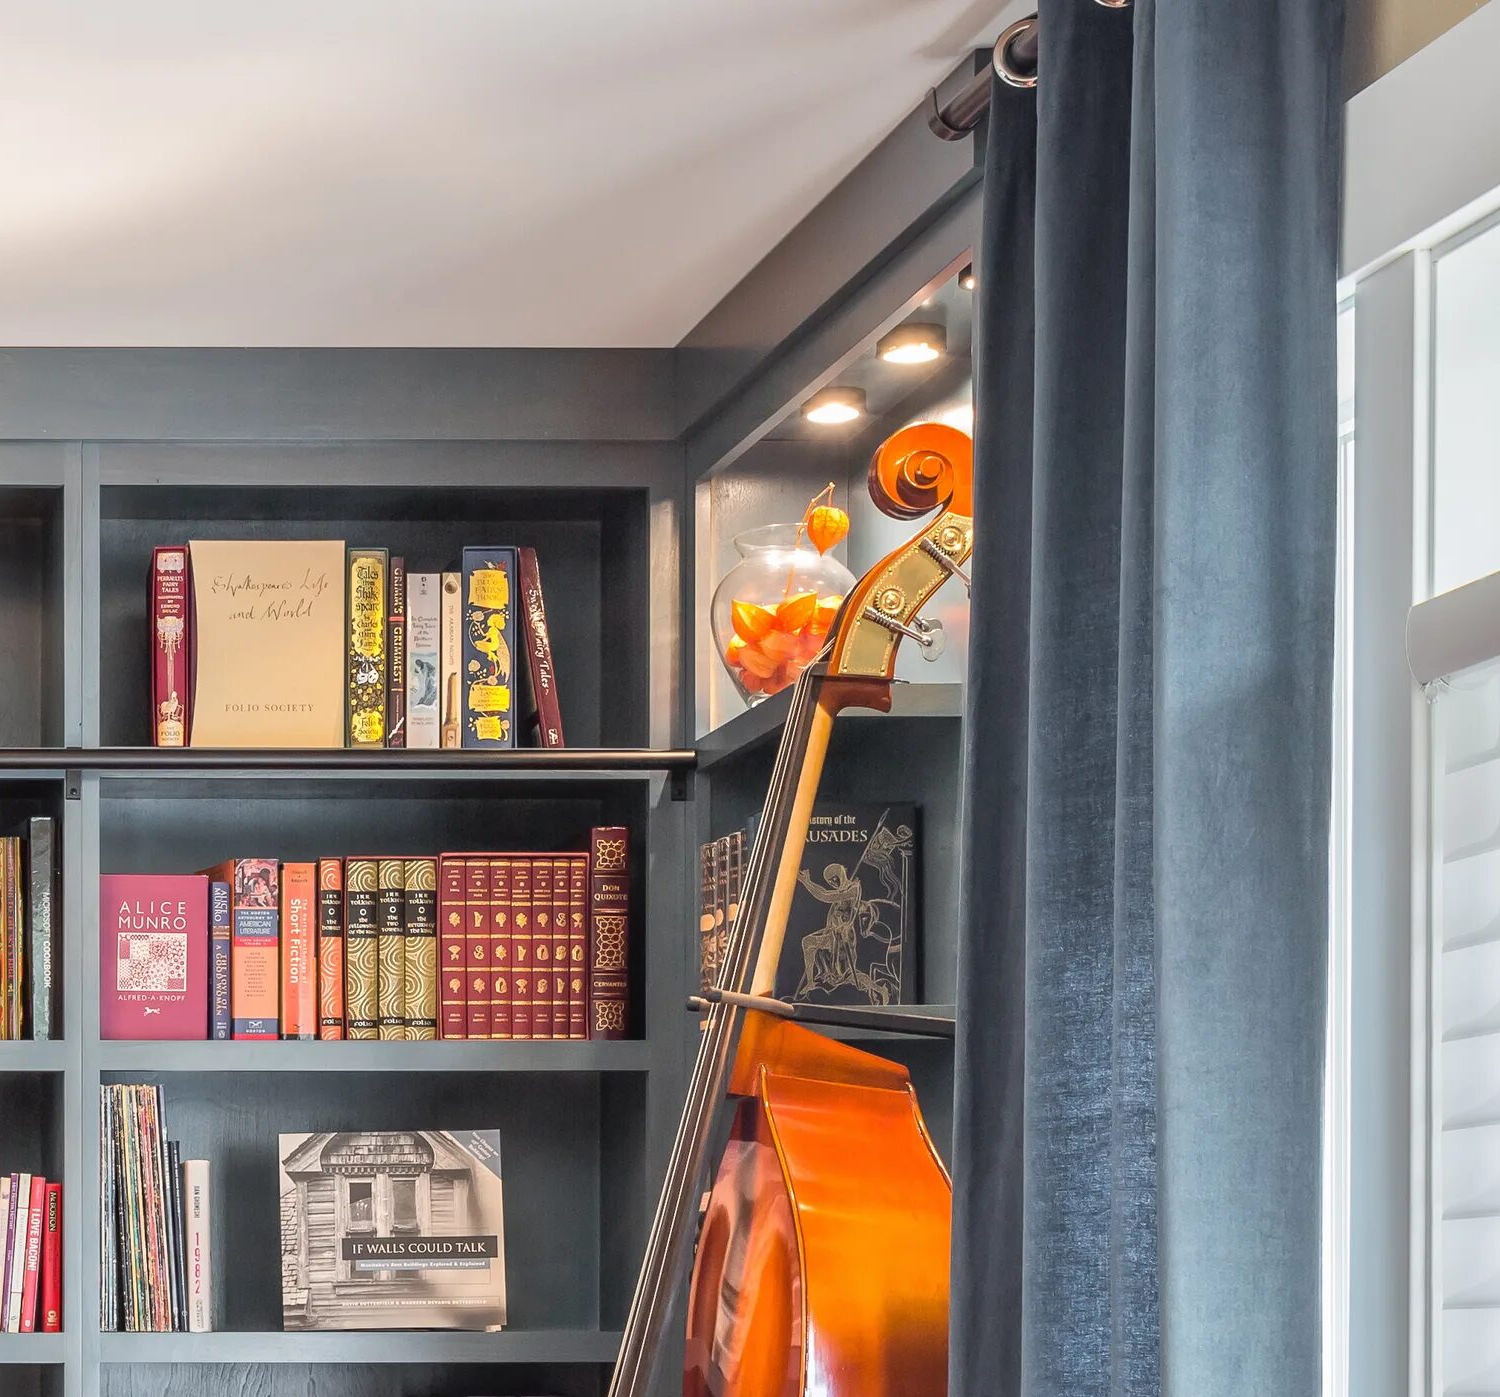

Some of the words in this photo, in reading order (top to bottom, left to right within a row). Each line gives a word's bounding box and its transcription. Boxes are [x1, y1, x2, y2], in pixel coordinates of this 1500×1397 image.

[299, 568, 329, 596] Life
[394, 567, 403, 614] GRIMM'S
[228, 604, 255, 619] and
[264, 600, 312, 618] World
[393, 627, 402, 684] GRIMMEST
[225, 703, 260, 712] FOLIO
[264, 703, 314, 712] SOCIETY
[835, 815, 843, 825] of
[844, 815, 856, 825] the
[804, 830, 869, 843] USADES
[42, 892, 50, 937] MICROSOFT
[119, 901, 187, 915] ALICE
[291, 899, 301, 934] Short
[118, 916, 187, 930] MUNRO
[42, 940, 51, 988] COOKBOOK
[291, 939, 301, 983] Fiction
[30, 1213, 40, 1236] LOVE
[27, 1237, 38, 1271] BACON!
[352, 1244, 364, 1254] IF
[367, 1243, 405, 1254] WALLS
[408, 1242, 452, 1253] COULD
[456, 1242, 486, 1252] TALK
